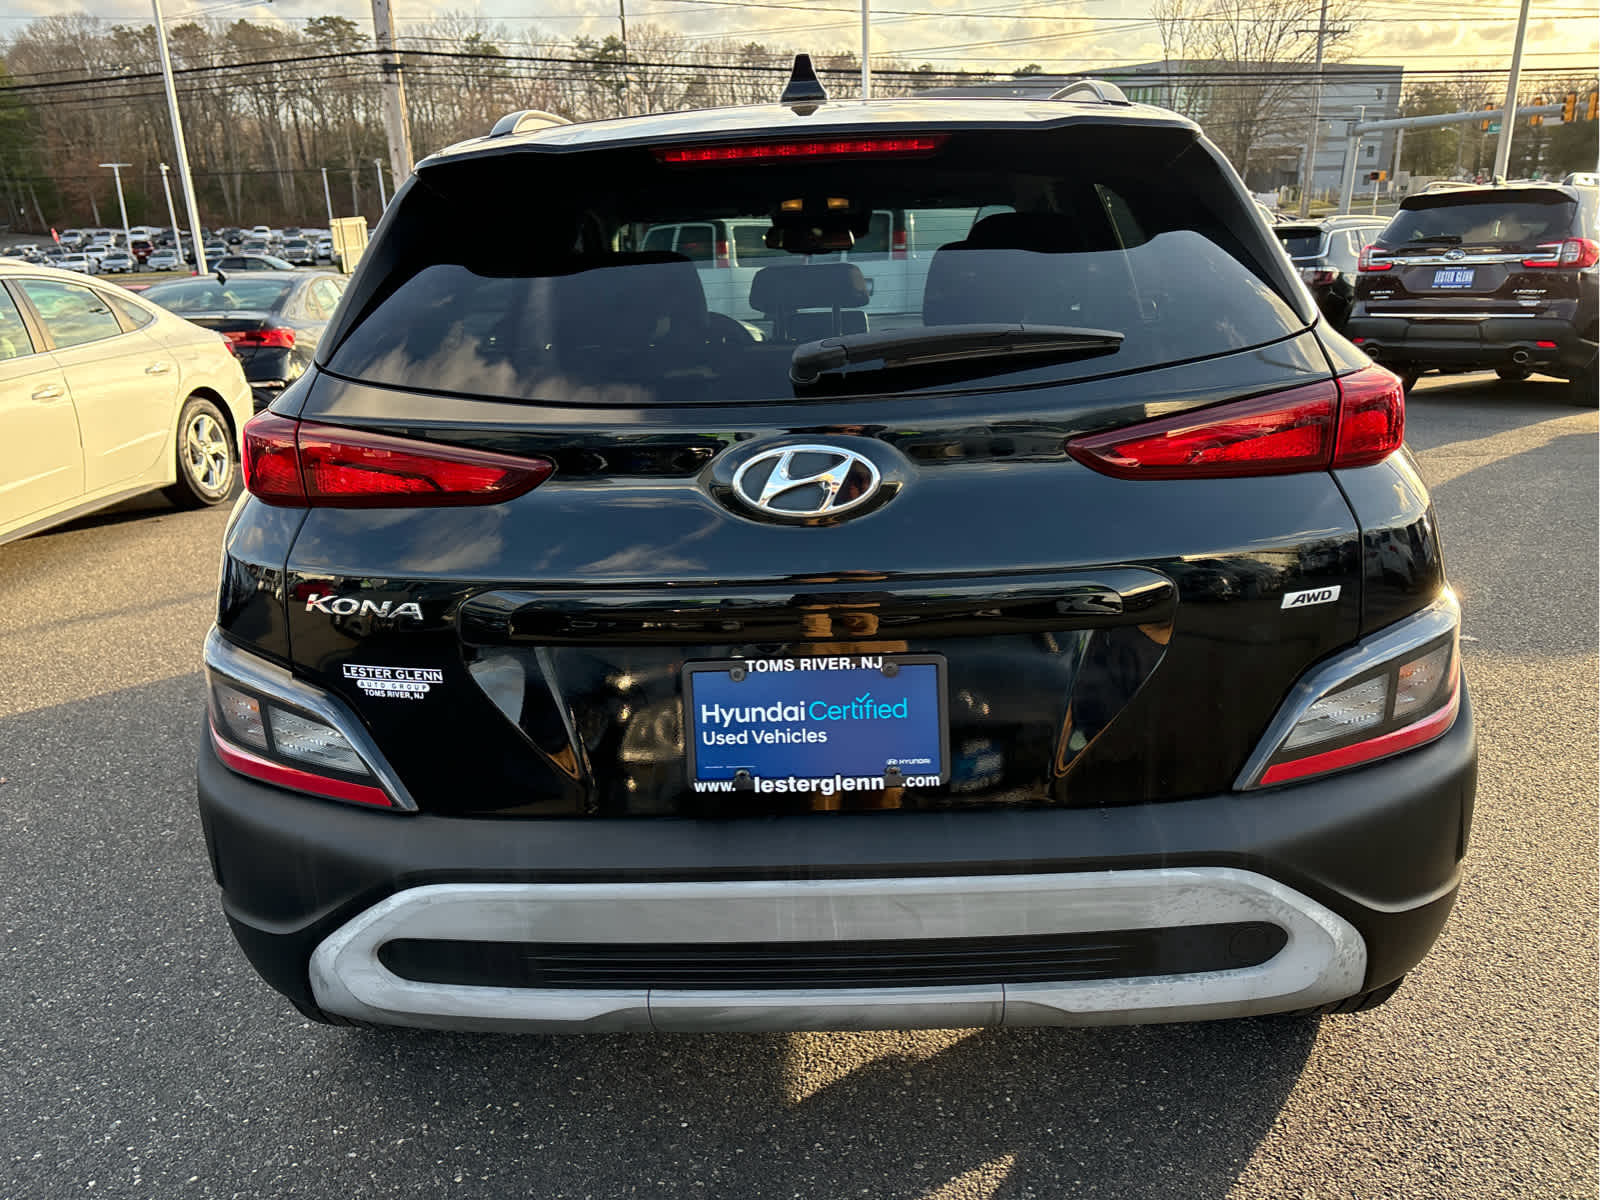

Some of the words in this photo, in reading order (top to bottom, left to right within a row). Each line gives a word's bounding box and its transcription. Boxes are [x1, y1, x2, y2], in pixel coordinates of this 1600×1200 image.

[1290, 590, 1332, 605] AWD
[305, 594, 424, 621] KONA
[745, 659, 795, 672] TOMS
[799, 657, 856, 671] RIVER,
[861, 656, 883, 669] NJ
[343, 666, 392, 679] LESTER
[395, 670, 443, 681] GLENN
[364, 689, 386, 697] TOMS
[387, 690, 413, 700] RIVER,
[701, 701, 806, 727] Hyundai
[808, 692, 908, 721] Certified
[702, 730, 748, 745] Used
[751, 729, 827, 744] Vehicles
[694, 780, 736, 792] www.
[753, 775, 885, 796] lesterglenn
[901, 775, 940, 788] .com
